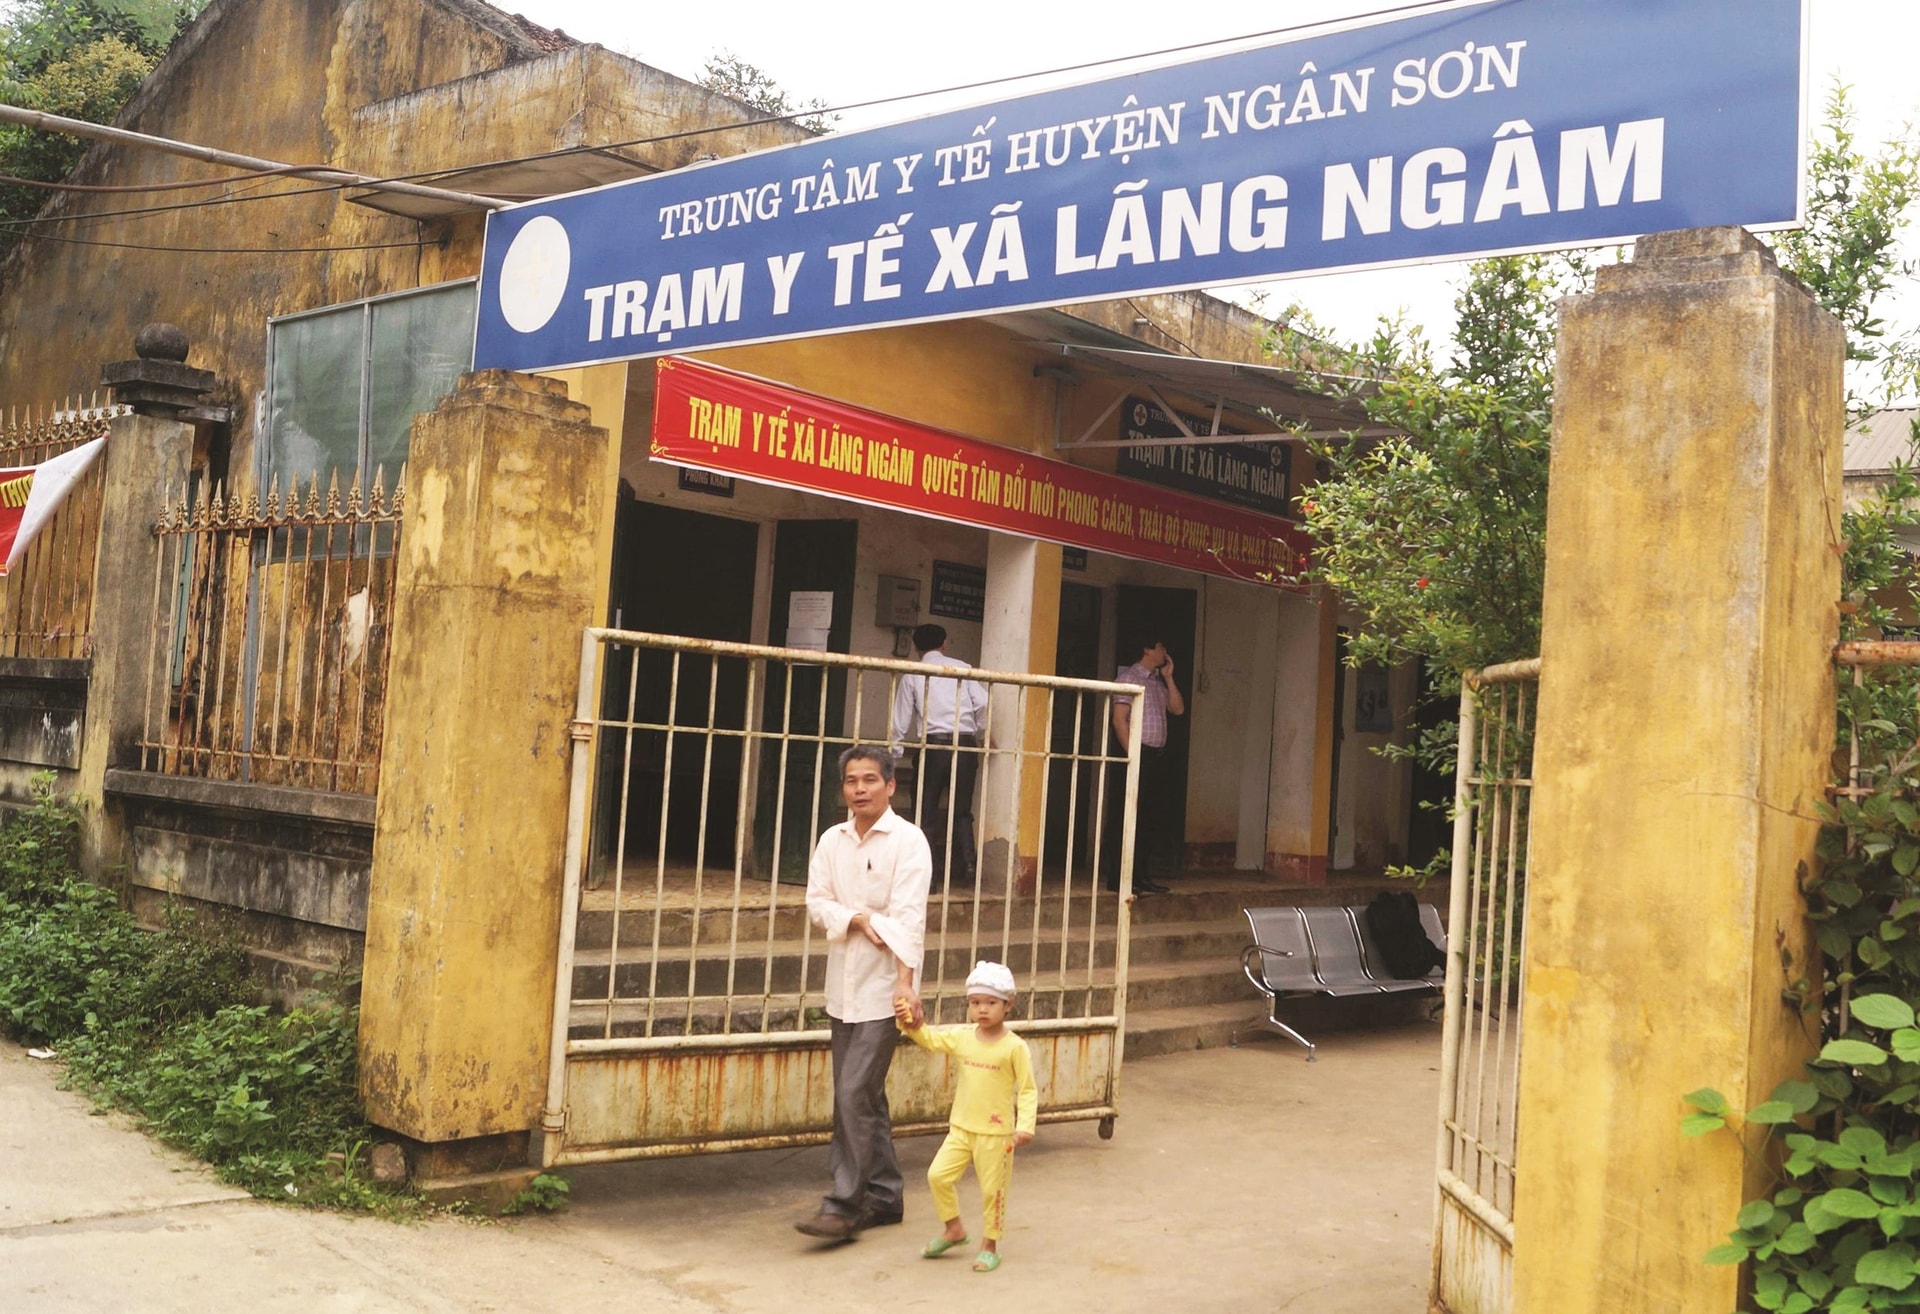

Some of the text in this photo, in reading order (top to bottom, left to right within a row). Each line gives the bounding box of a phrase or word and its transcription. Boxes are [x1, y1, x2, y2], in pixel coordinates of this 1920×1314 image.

[659, 40, 1527, 240] TRUNG TÂM Y TẾ HUYỆN NGÂN SƠN
[584, 117, 1665, 343] TRẠM Y TẾ XÃ LÃNG NGÂM
[689, 396, 742, 453] TRẠM
[752, 412, 764, 453] Y
[768, 405, 792, 458] TẾ
[791, 417, 816, 465] XÃ
[819, 423, 864, 475] LÃNG
[866, 438, 915, 487] NGÂM
[922, 448, 968, 499] QUYẾT
[971, 460, 1001, 506] TÂM
[1003, 463, 1027, 513] ĐỔI
[1029, 473, 1055, 518] MỚI
[1057, 486, 1100, 529] PHONG
[1139, 504, 1163, 543] THÁI
[1198, 447, 1214, 481] XÃ
[1217, 453, 1248, 490] LÃNG
